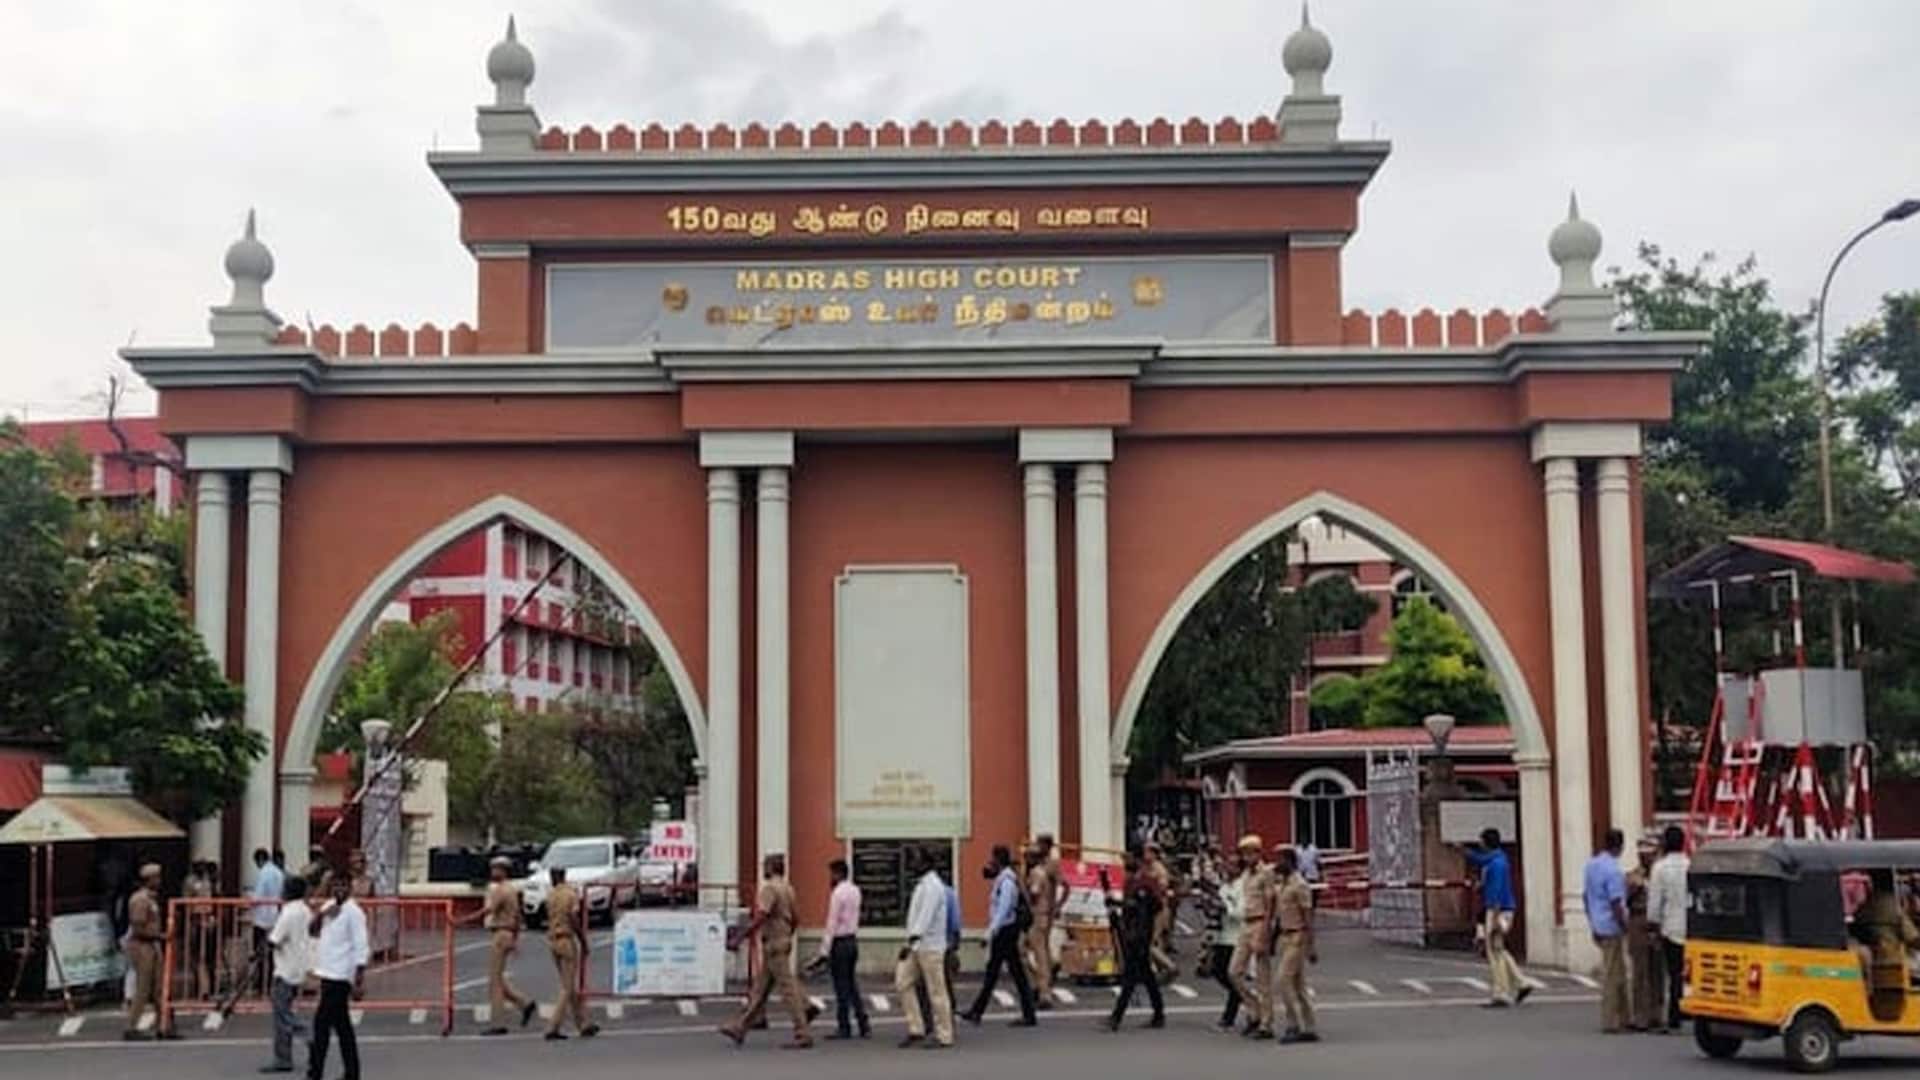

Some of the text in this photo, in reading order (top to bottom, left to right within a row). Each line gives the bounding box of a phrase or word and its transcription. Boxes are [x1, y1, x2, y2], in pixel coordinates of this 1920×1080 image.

[736, 267, 1081, 290] MADRAS HIGH COURT
[665, 826, 683, 838] NO
